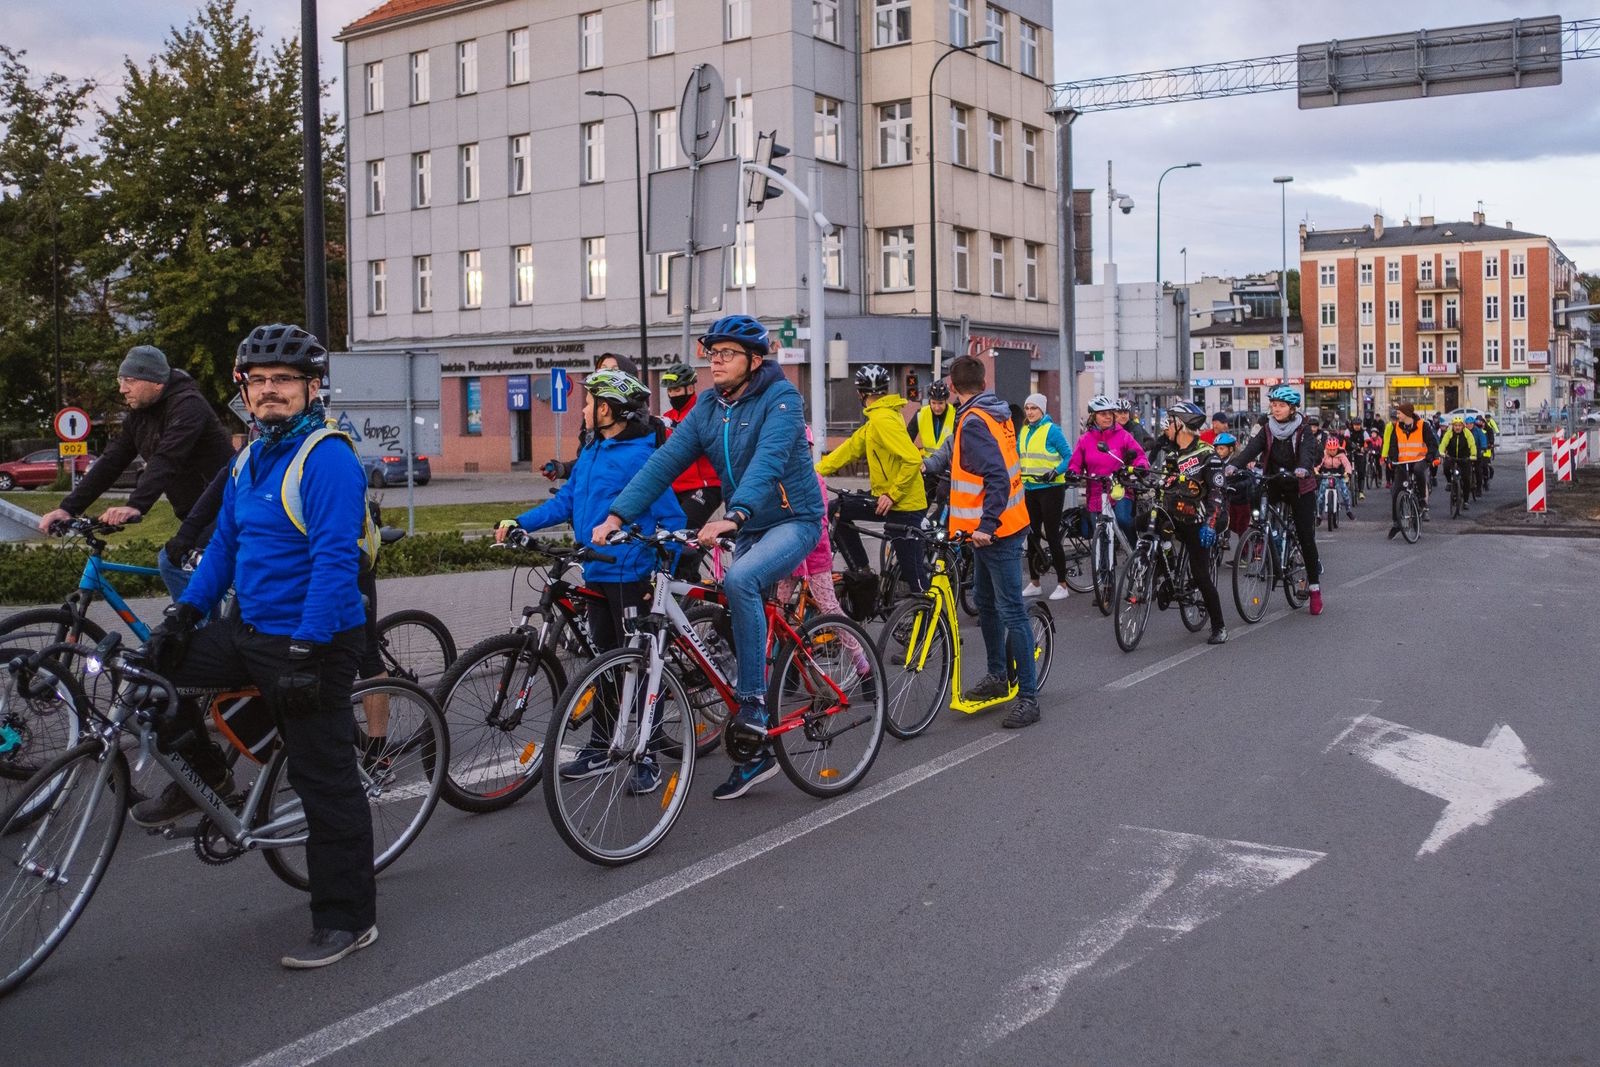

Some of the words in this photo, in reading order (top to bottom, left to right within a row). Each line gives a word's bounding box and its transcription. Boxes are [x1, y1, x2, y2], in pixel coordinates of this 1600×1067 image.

[513, 345, 555, 355] MOSTOSTAL
[557, 343, 585, 353] ZABRZE
[513, 394, 523, 407] 10
[64, 445, 81, 453] 902
[682, 624, 722, 672] author
[181, 761, 222, 811] PAWLAK
